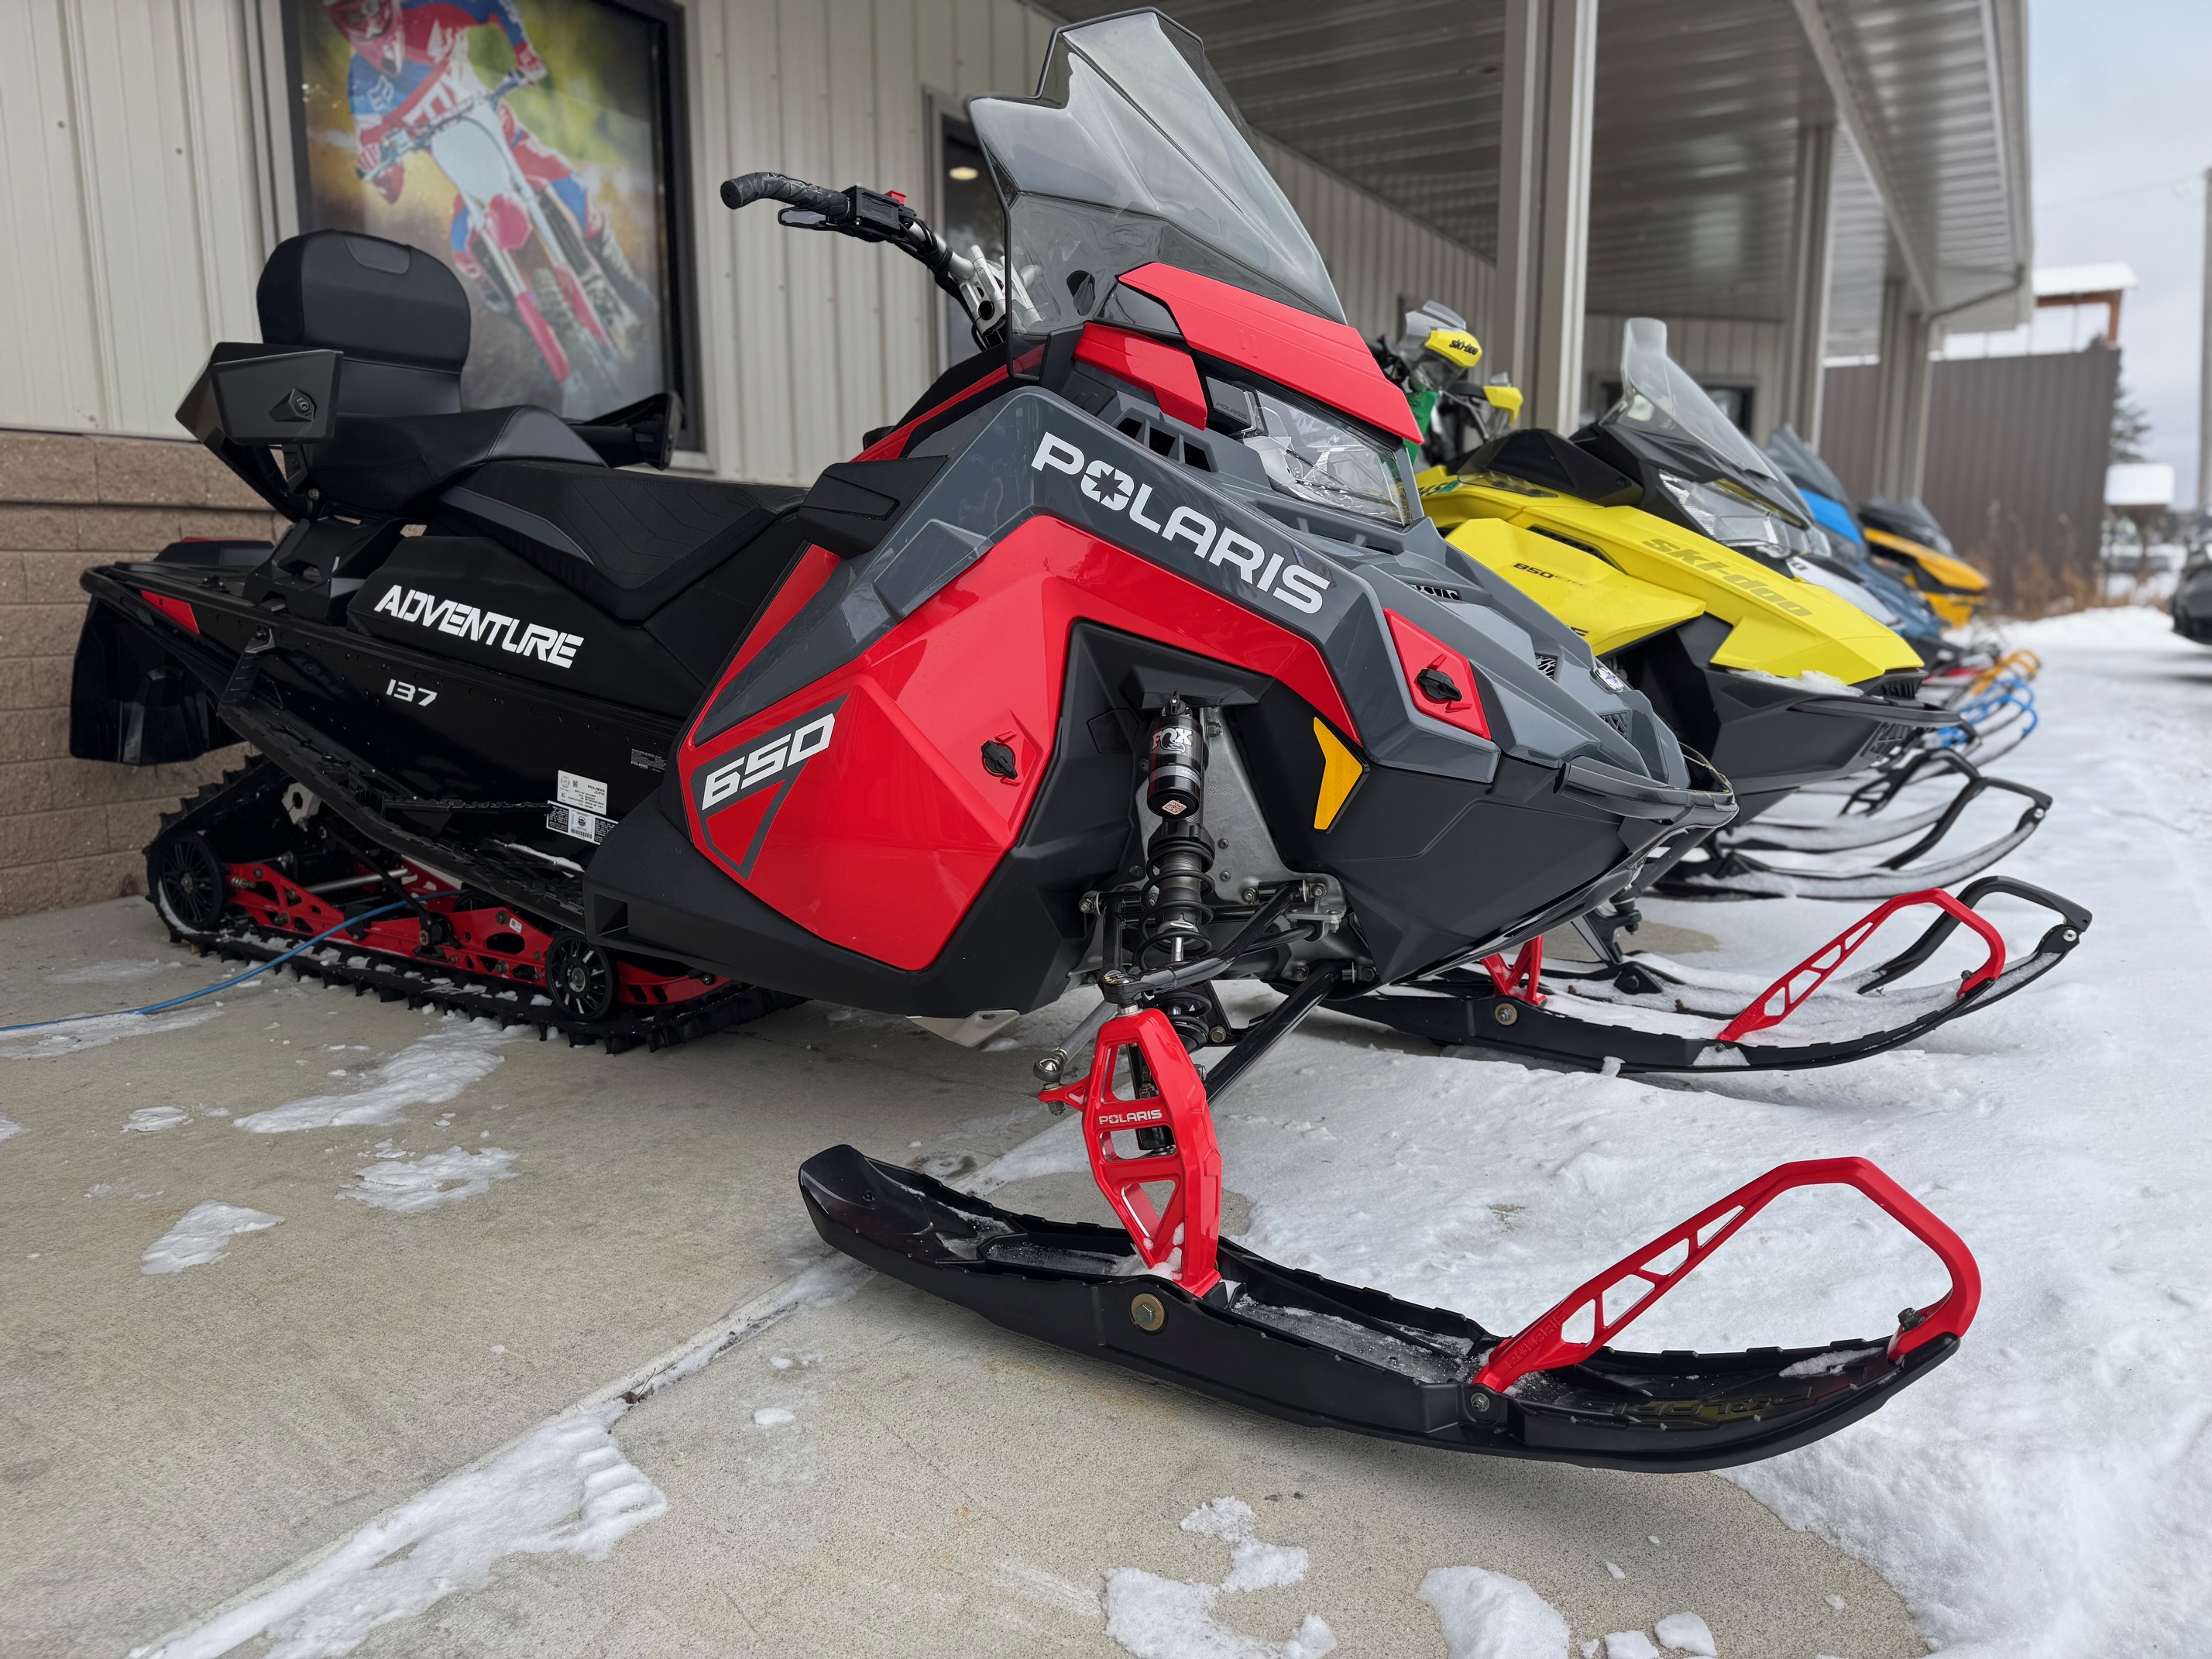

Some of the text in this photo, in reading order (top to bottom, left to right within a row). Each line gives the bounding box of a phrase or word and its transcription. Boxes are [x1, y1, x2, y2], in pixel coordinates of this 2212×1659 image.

[1216, 401, 1248, 419] POLARIS
[1031, 431, 1331, 614] POLARIS
[1513, 562, 1555, 579] 850
[373, 584, 585, 669] ADVENTURE
[386, 678, 438, 707] 137
[1152, 726, 1193, 754] FOX
[701, 713, 836, 811] 650
[1098, 1108, 1163, 1125] POLARIS
[1504, 1310, 1568, 1369] POLARIS
[1582, 1386, 1812, 1416] POLARIS
